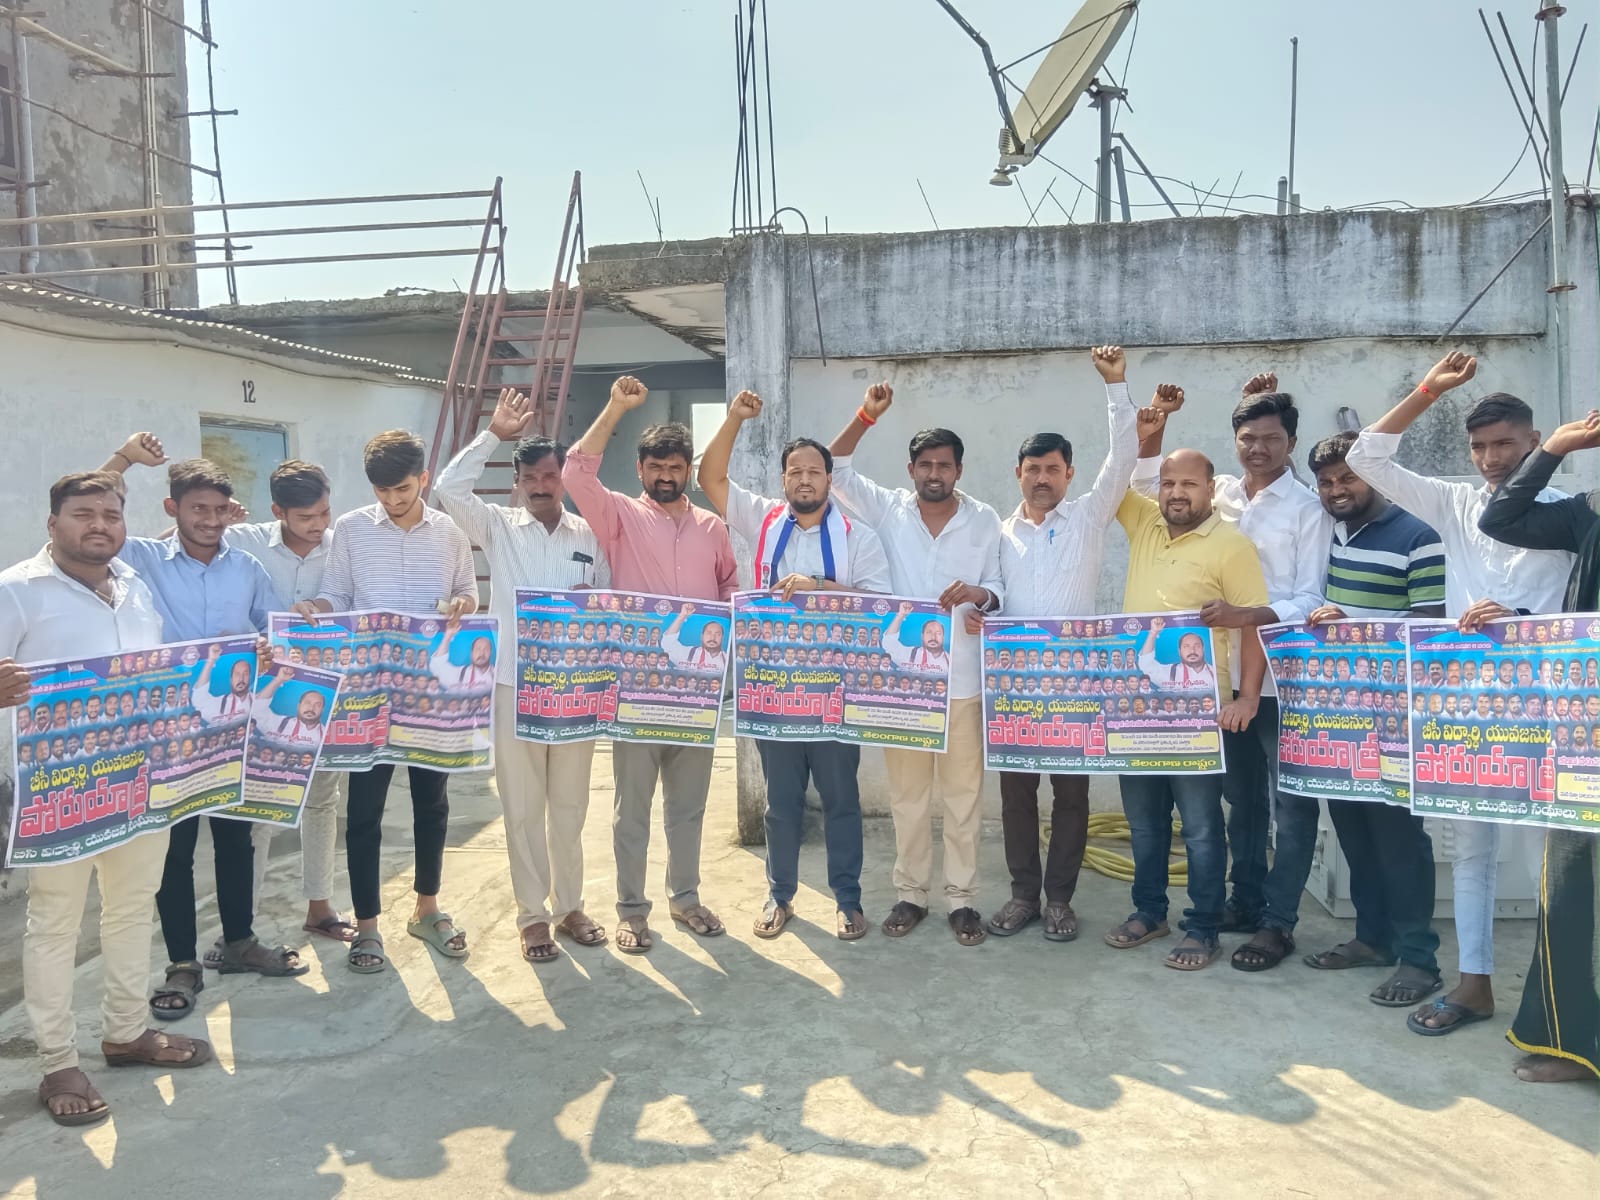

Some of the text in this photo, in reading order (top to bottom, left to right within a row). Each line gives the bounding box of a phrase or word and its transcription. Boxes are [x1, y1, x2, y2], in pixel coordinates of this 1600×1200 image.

[242, 380, 256, 403] 12
[518, 683, 620, 723] పోరుయాత్ర
[739, 682, 844, 725] పోరుయాత్ర
[988, 714, 1107, 757] పోరుయాత్ర
[1422, 718, 1441, 741] బీసీ
[30, 766, 50, 792] బీసీ
[1131, 759, 1181, 768] తెలంగాణ
[1415, 743, 1556, 803] పోరుయాత్ర
[19, 765, 149, 837] పోరుయాత్ర
